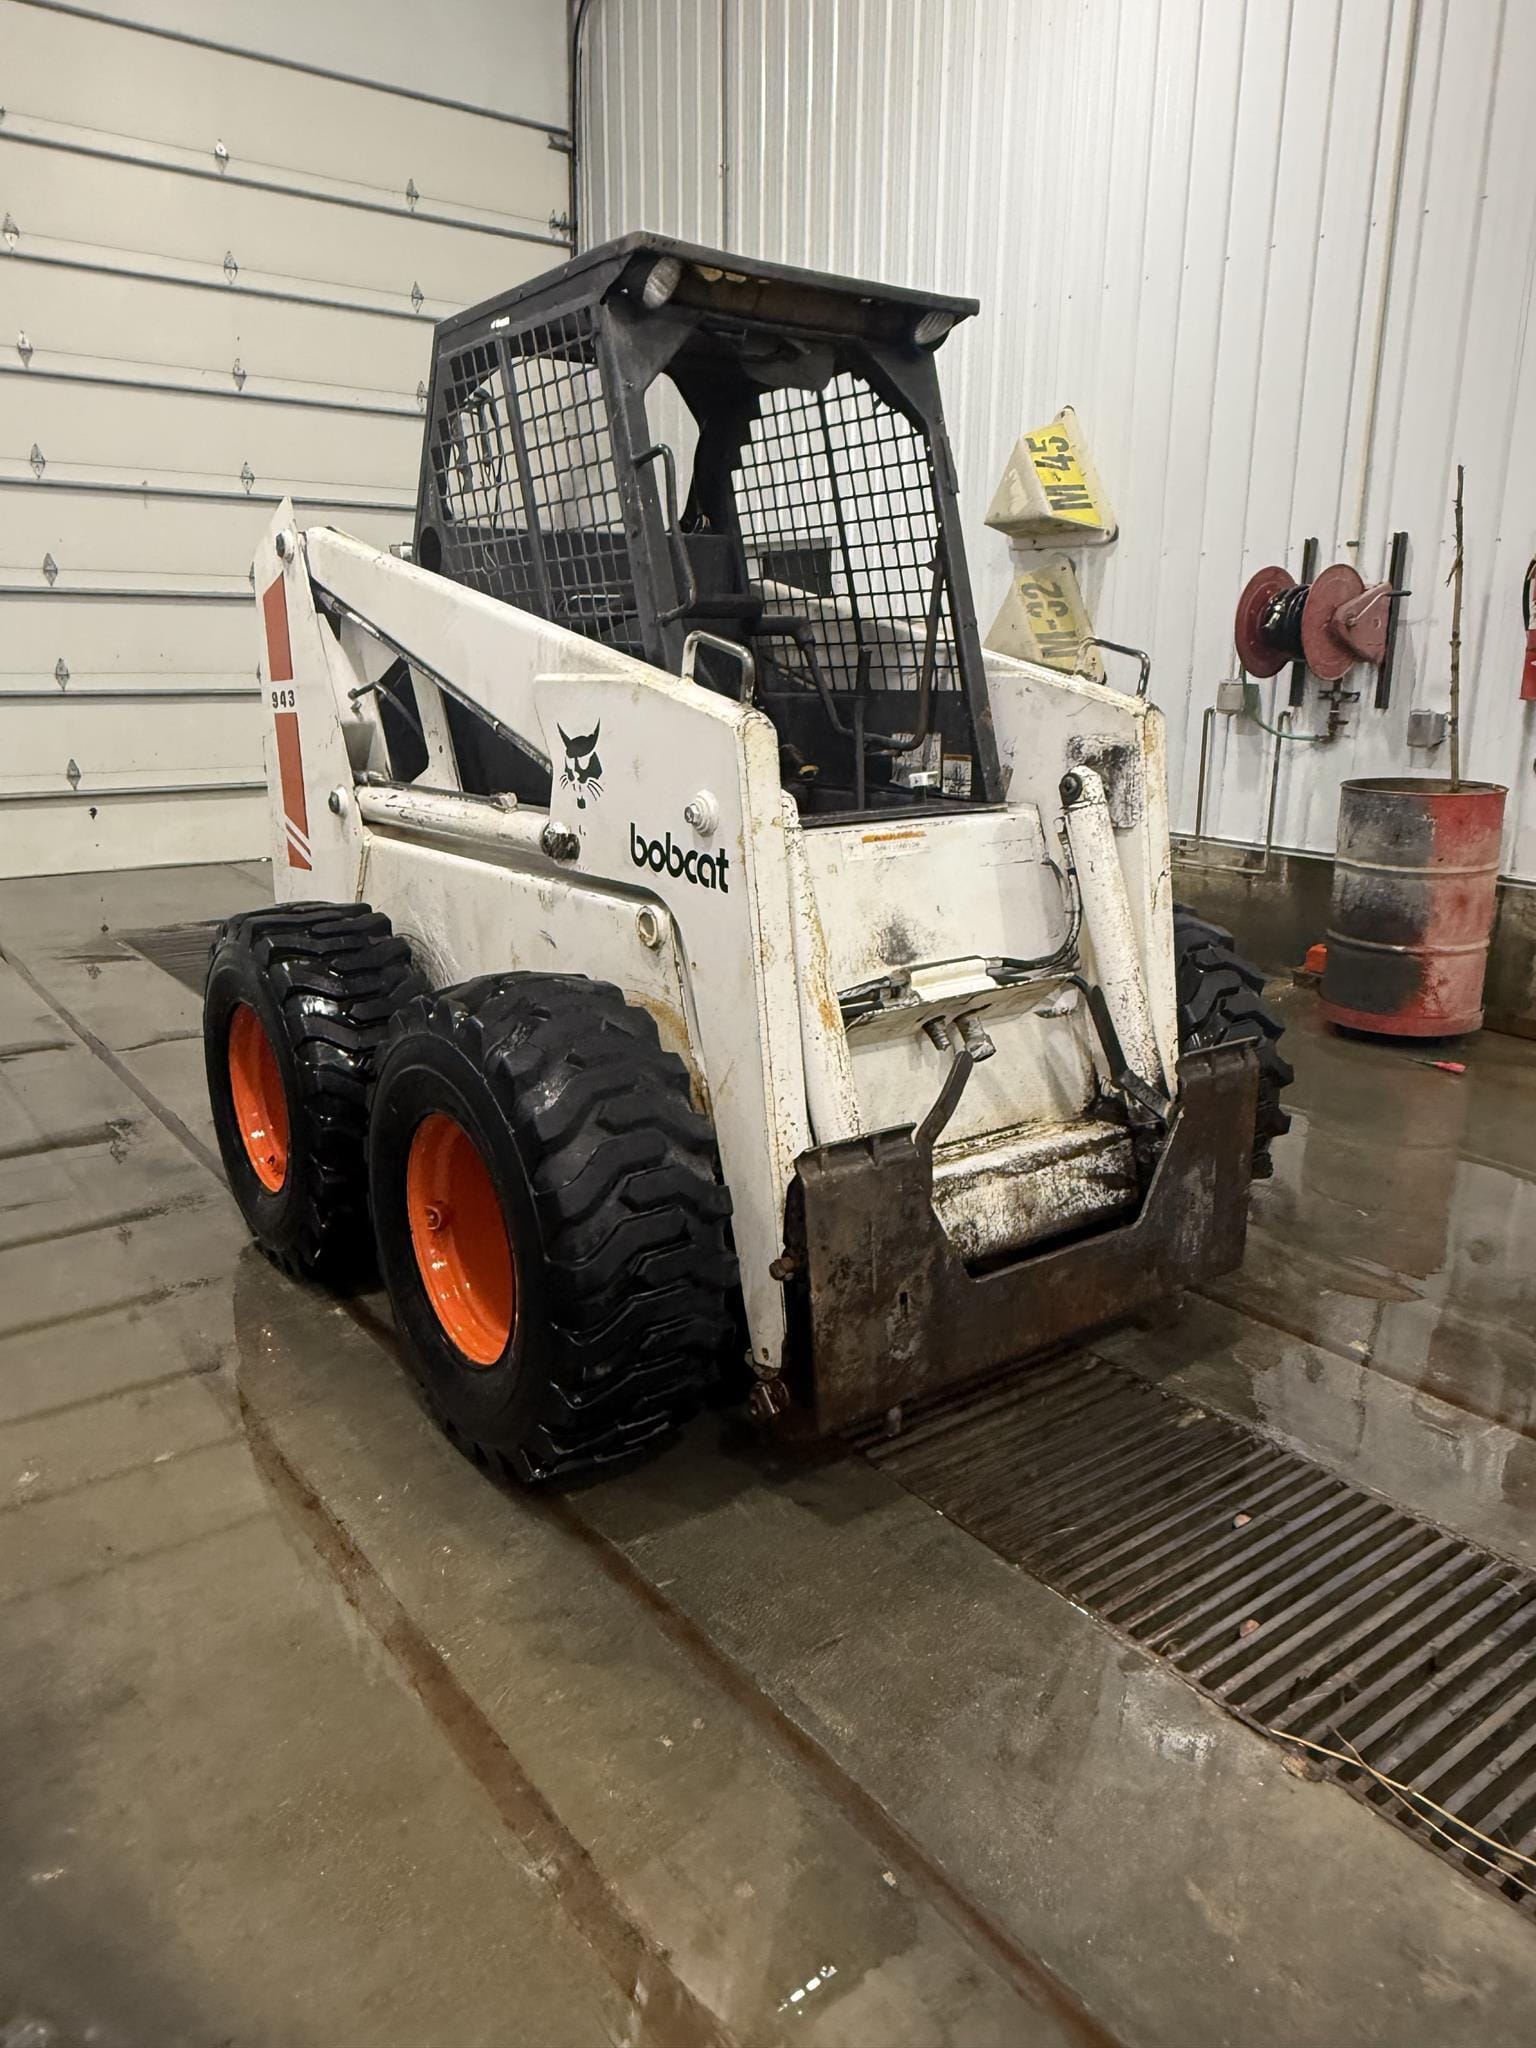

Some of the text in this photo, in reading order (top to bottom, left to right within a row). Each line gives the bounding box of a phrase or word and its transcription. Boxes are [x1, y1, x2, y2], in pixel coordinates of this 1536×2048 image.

[1024, 435, 1094, 511] M-45
[1021, 582, 1081, 659] M-32
[272, 690, 295, 708] 943
[630, 822, 729, 894] bobcat
